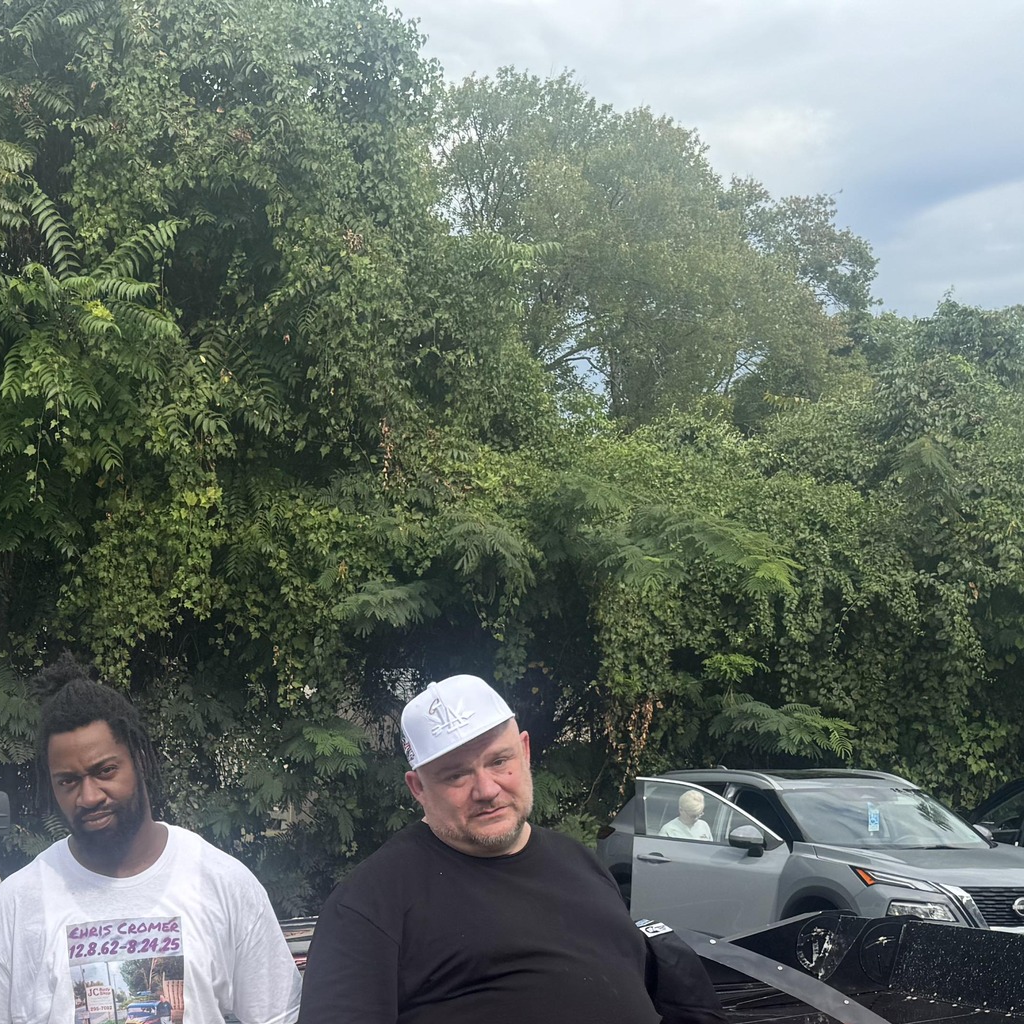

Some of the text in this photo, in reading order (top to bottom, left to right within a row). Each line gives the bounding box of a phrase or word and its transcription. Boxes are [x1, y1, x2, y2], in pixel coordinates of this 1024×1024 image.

[69, 921, 180, 939] CHRIS CROMER
[87, 988, 99, 997] JC
